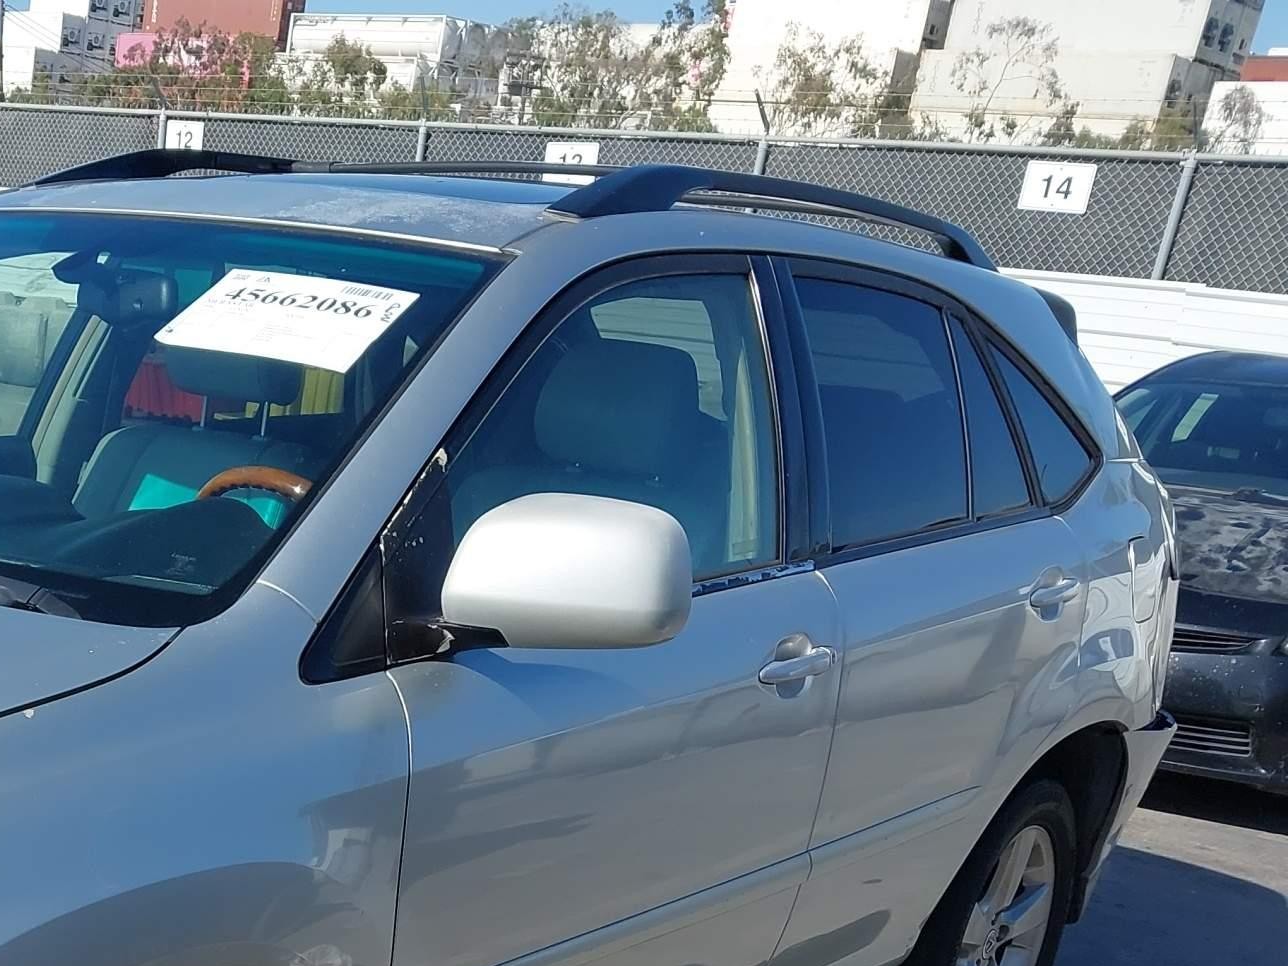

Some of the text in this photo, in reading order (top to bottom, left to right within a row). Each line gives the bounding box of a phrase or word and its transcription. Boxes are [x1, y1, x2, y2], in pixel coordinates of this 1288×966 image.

[176, 130, 193, 149] 12
[1042, 174, 1073, 200] 14
[225, 287, 377, 318] 45662086
